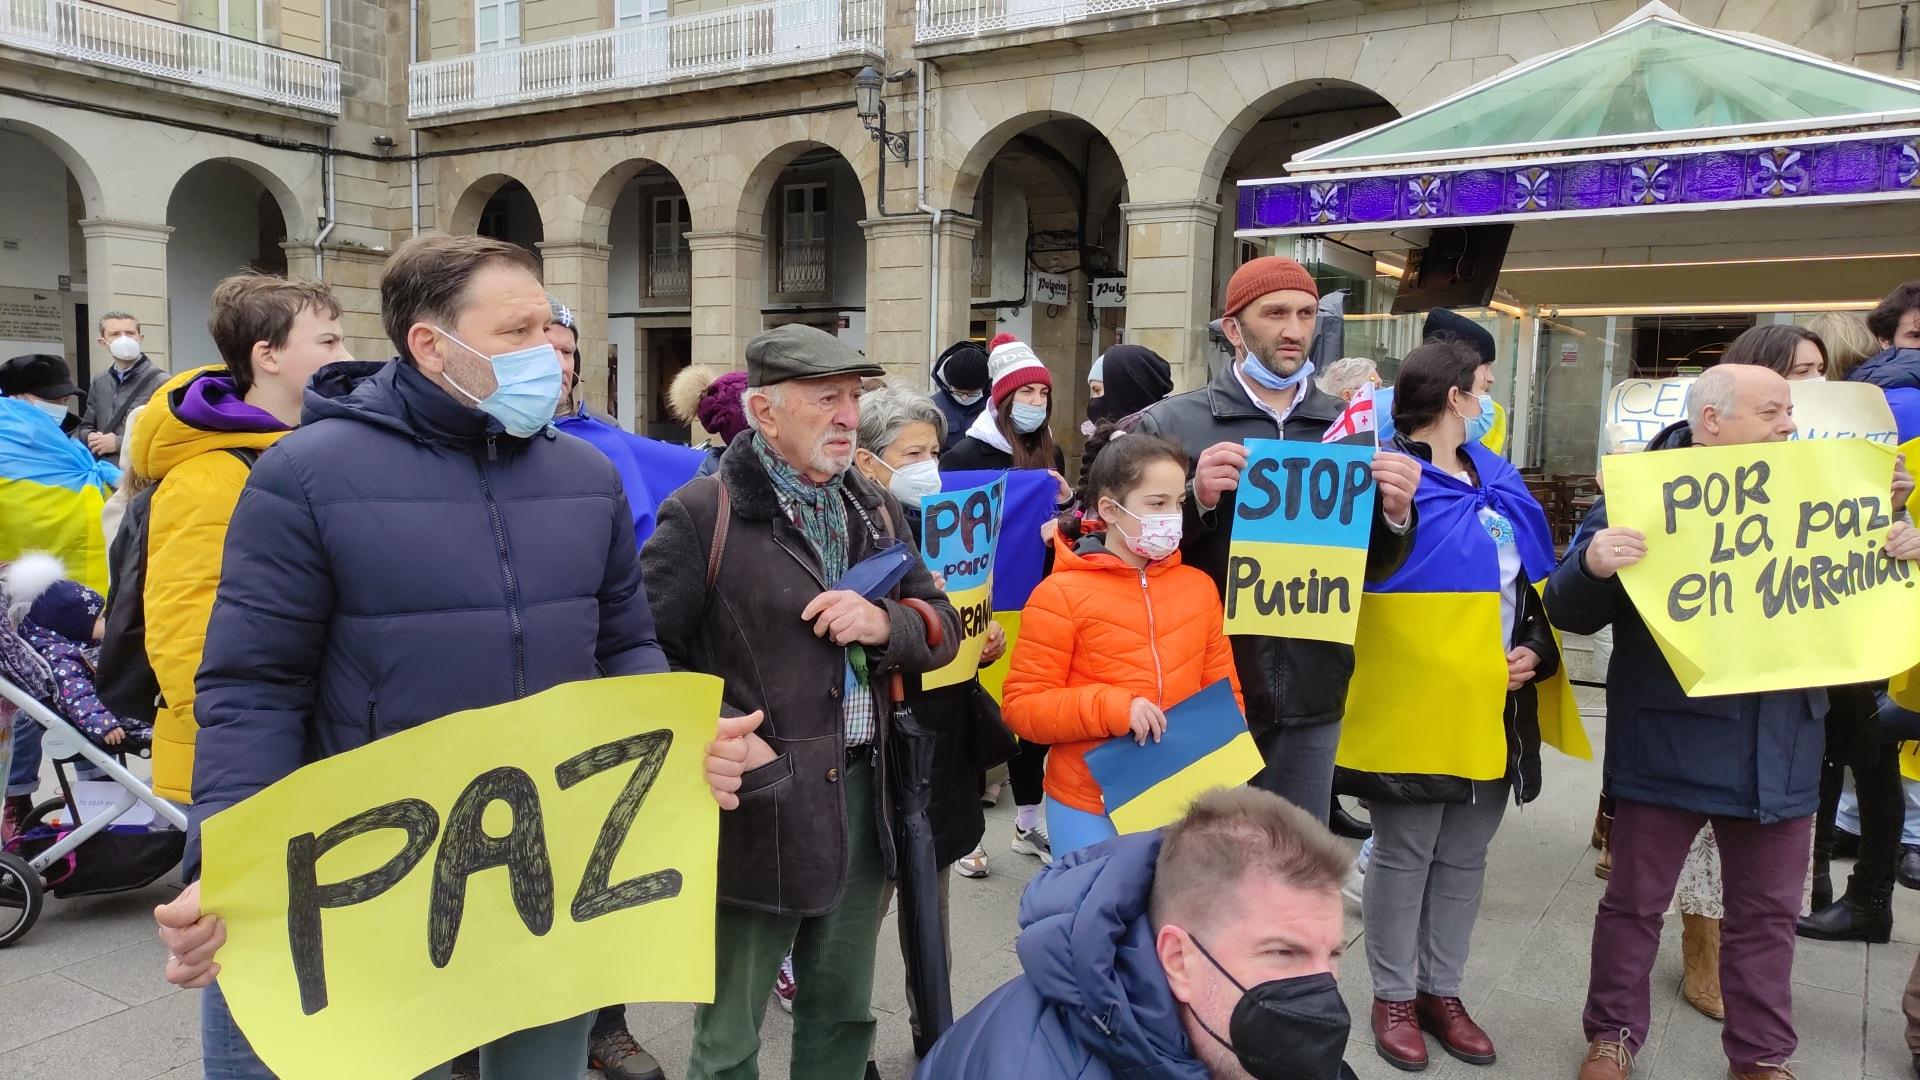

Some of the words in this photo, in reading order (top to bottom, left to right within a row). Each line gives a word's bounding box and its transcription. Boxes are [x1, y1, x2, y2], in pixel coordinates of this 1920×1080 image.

[1237, 457, 1372, 526] STOP
[943, 553, 989, 582] para
[1227, 555, 1350, 620] Putin
[1667, 570, 1734, 622] en
[287, 728, 682, 1016] PAZ
